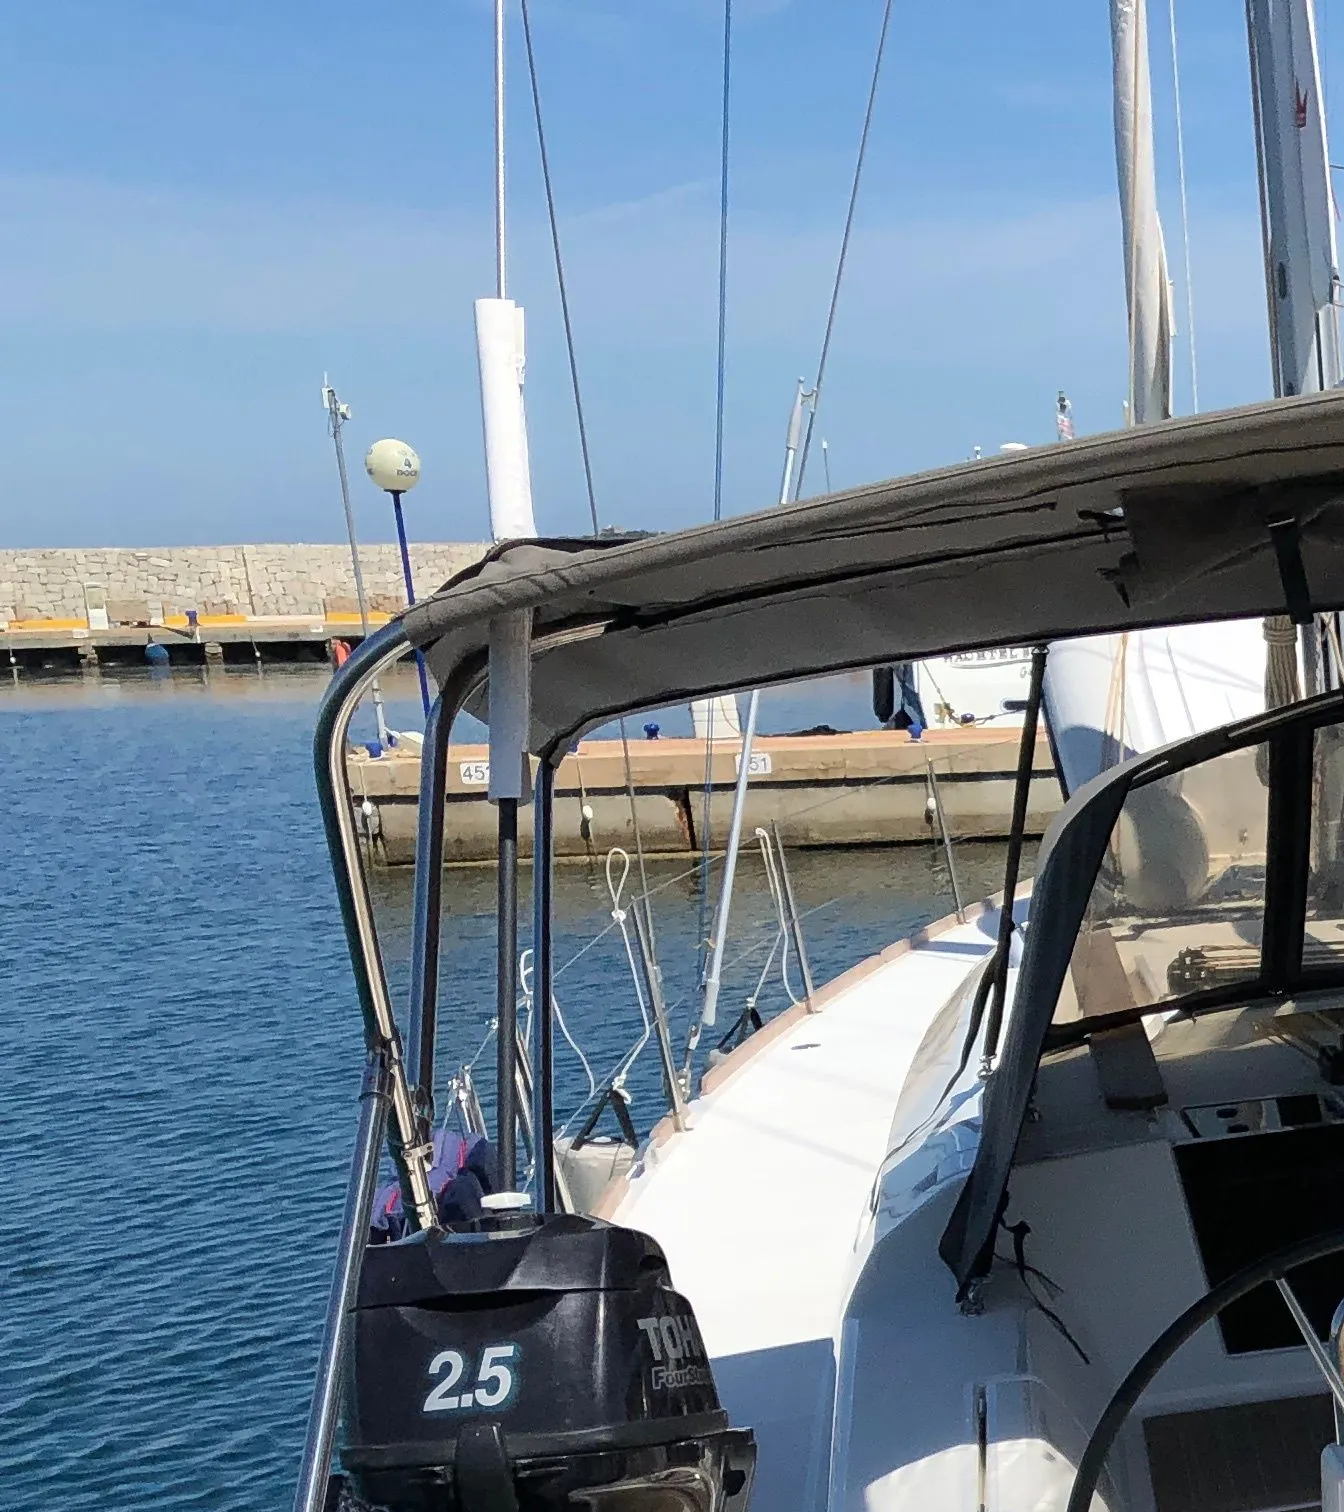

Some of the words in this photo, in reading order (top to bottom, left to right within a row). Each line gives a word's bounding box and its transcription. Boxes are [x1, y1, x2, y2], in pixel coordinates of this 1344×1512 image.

[462, 765, 490, 781] 45
[637, 1315, 702, 1361] TOH
[423, 1345, 514, 1412] 2.5
